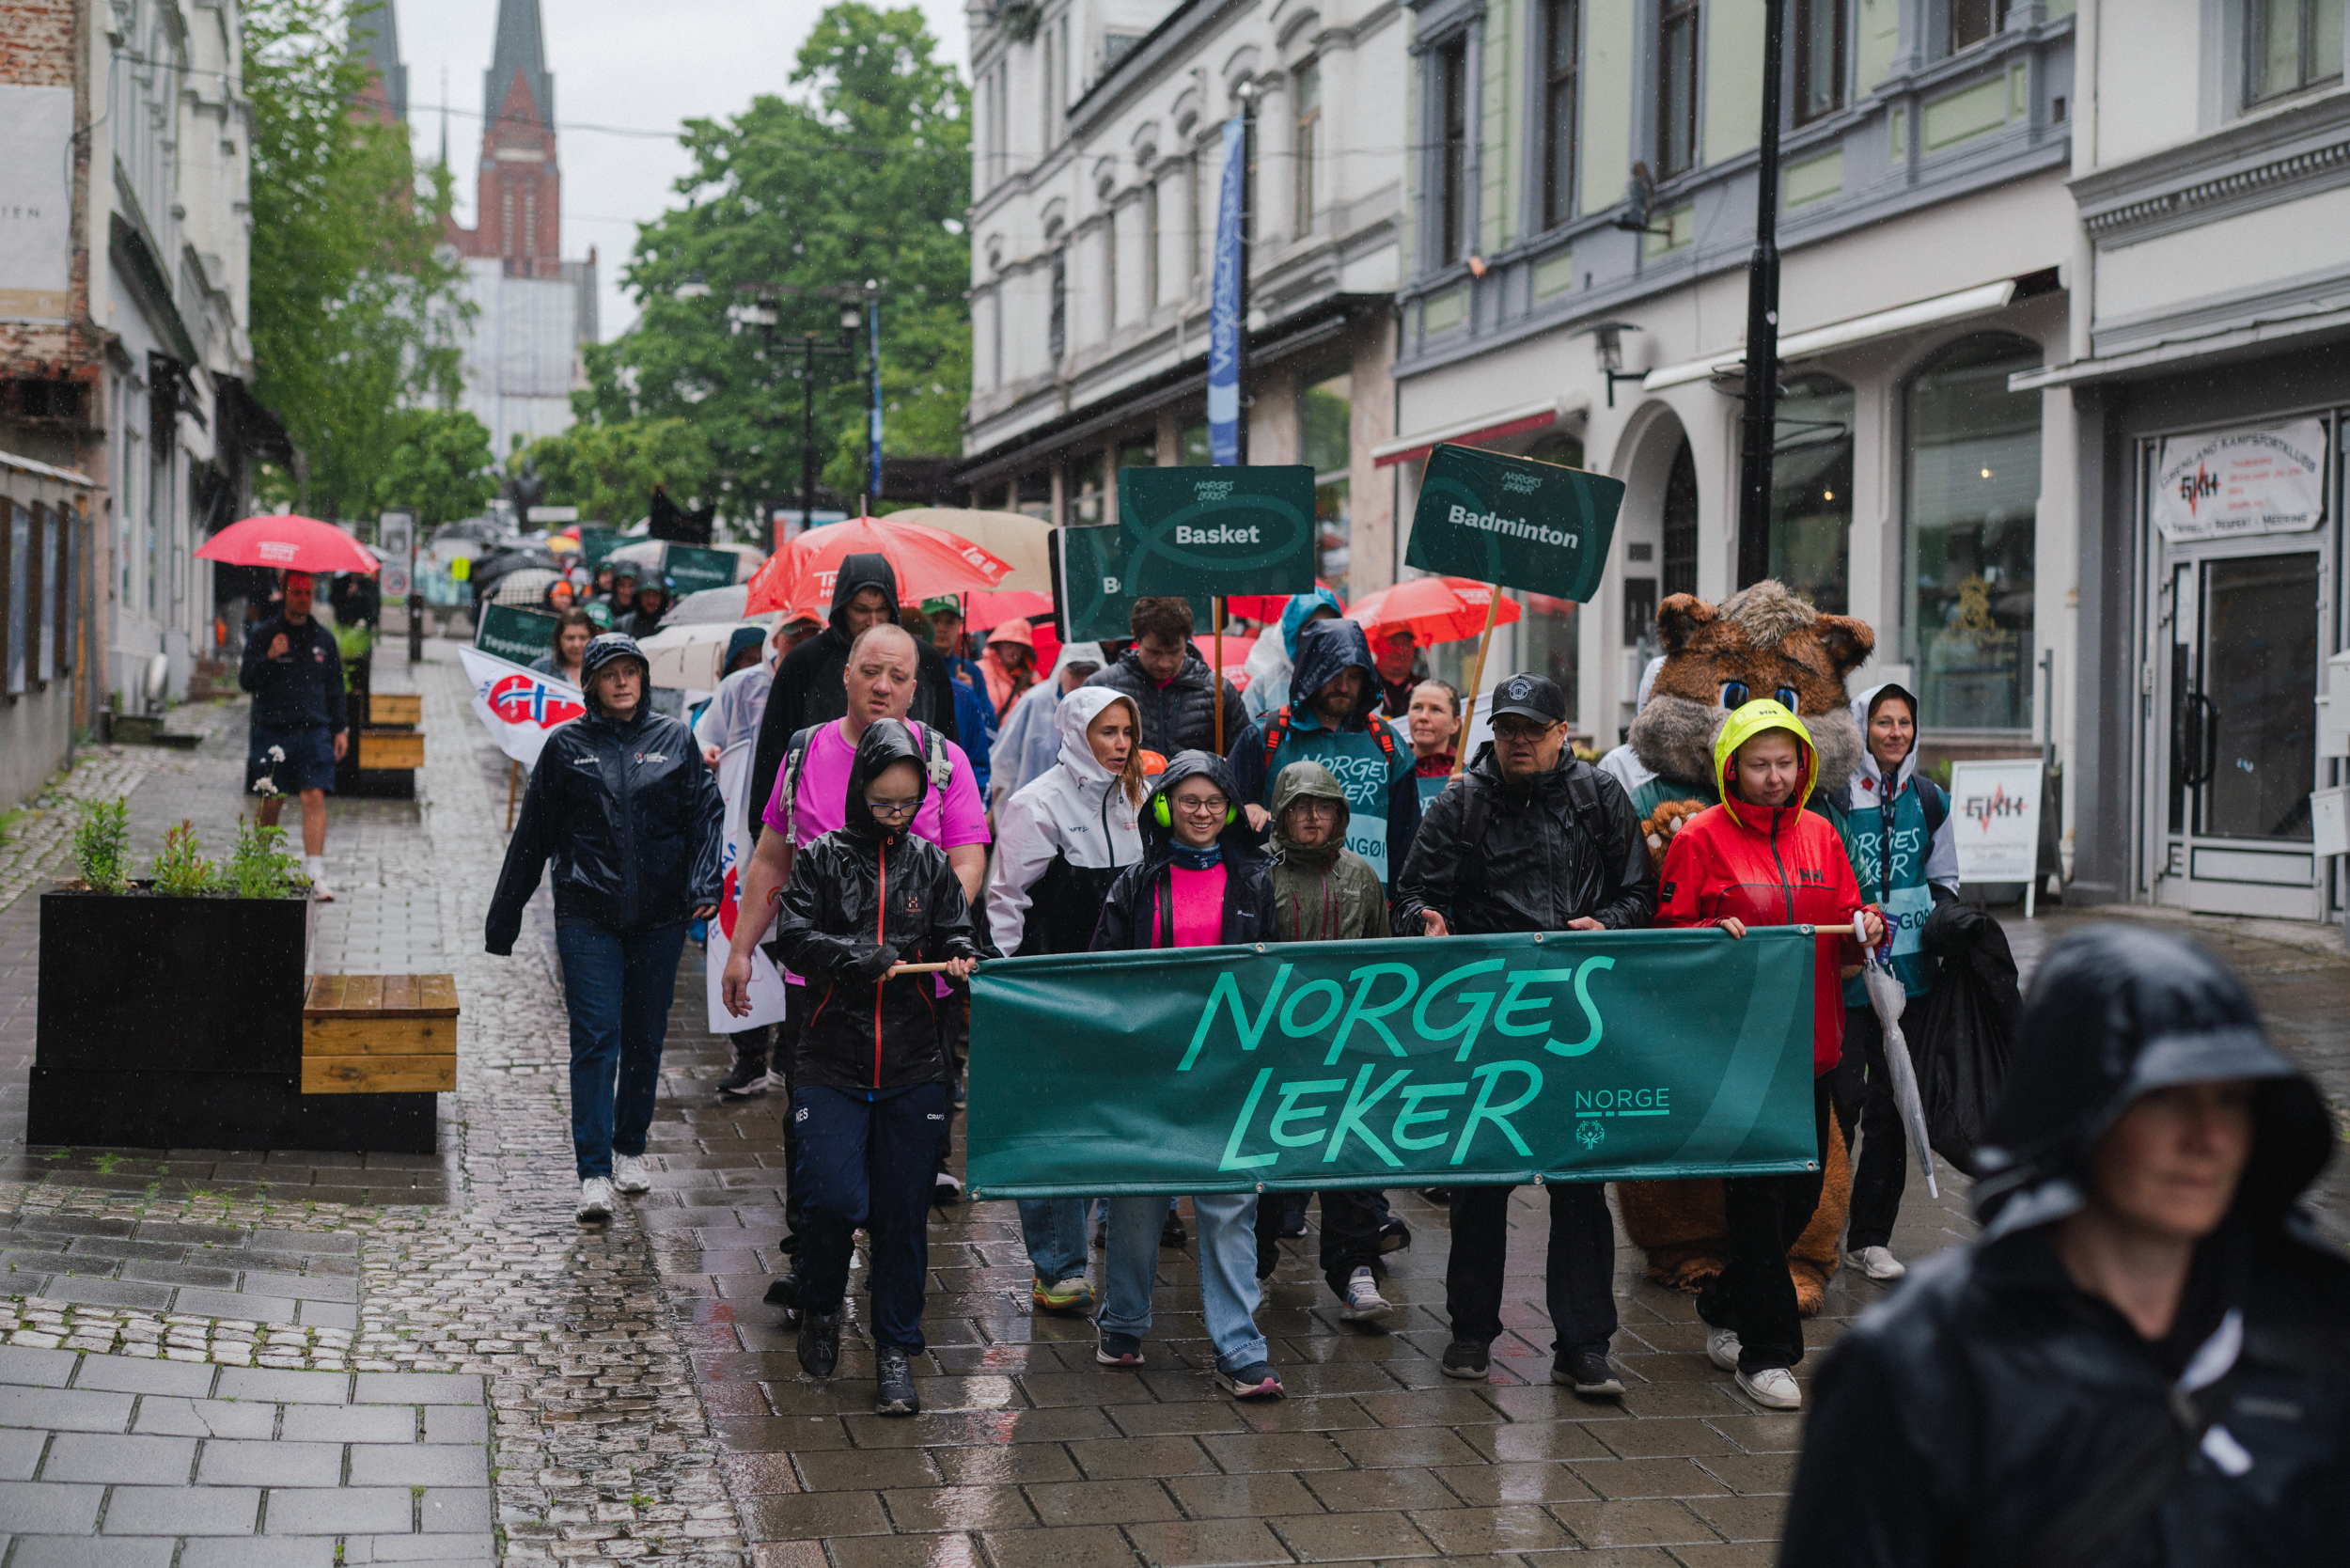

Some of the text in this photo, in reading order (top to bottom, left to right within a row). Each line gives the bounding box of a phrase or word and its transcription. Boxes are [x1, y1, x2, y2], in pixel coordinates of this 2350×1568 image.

[1193, 480, 1234, 492] NORGES
[1198, 490, 1228, 501] LEKER
[1176, 524, 1260, 544] Basket
[1449, 505, 1578, 549] Badminton
[1798, 868, 1825, 883] HH
[1176, 956, 1616, 1072] NORGES
[1575, 1088, 1669, 1109] NORGE
[1217, 1059, 1543, 1172] LEKER
